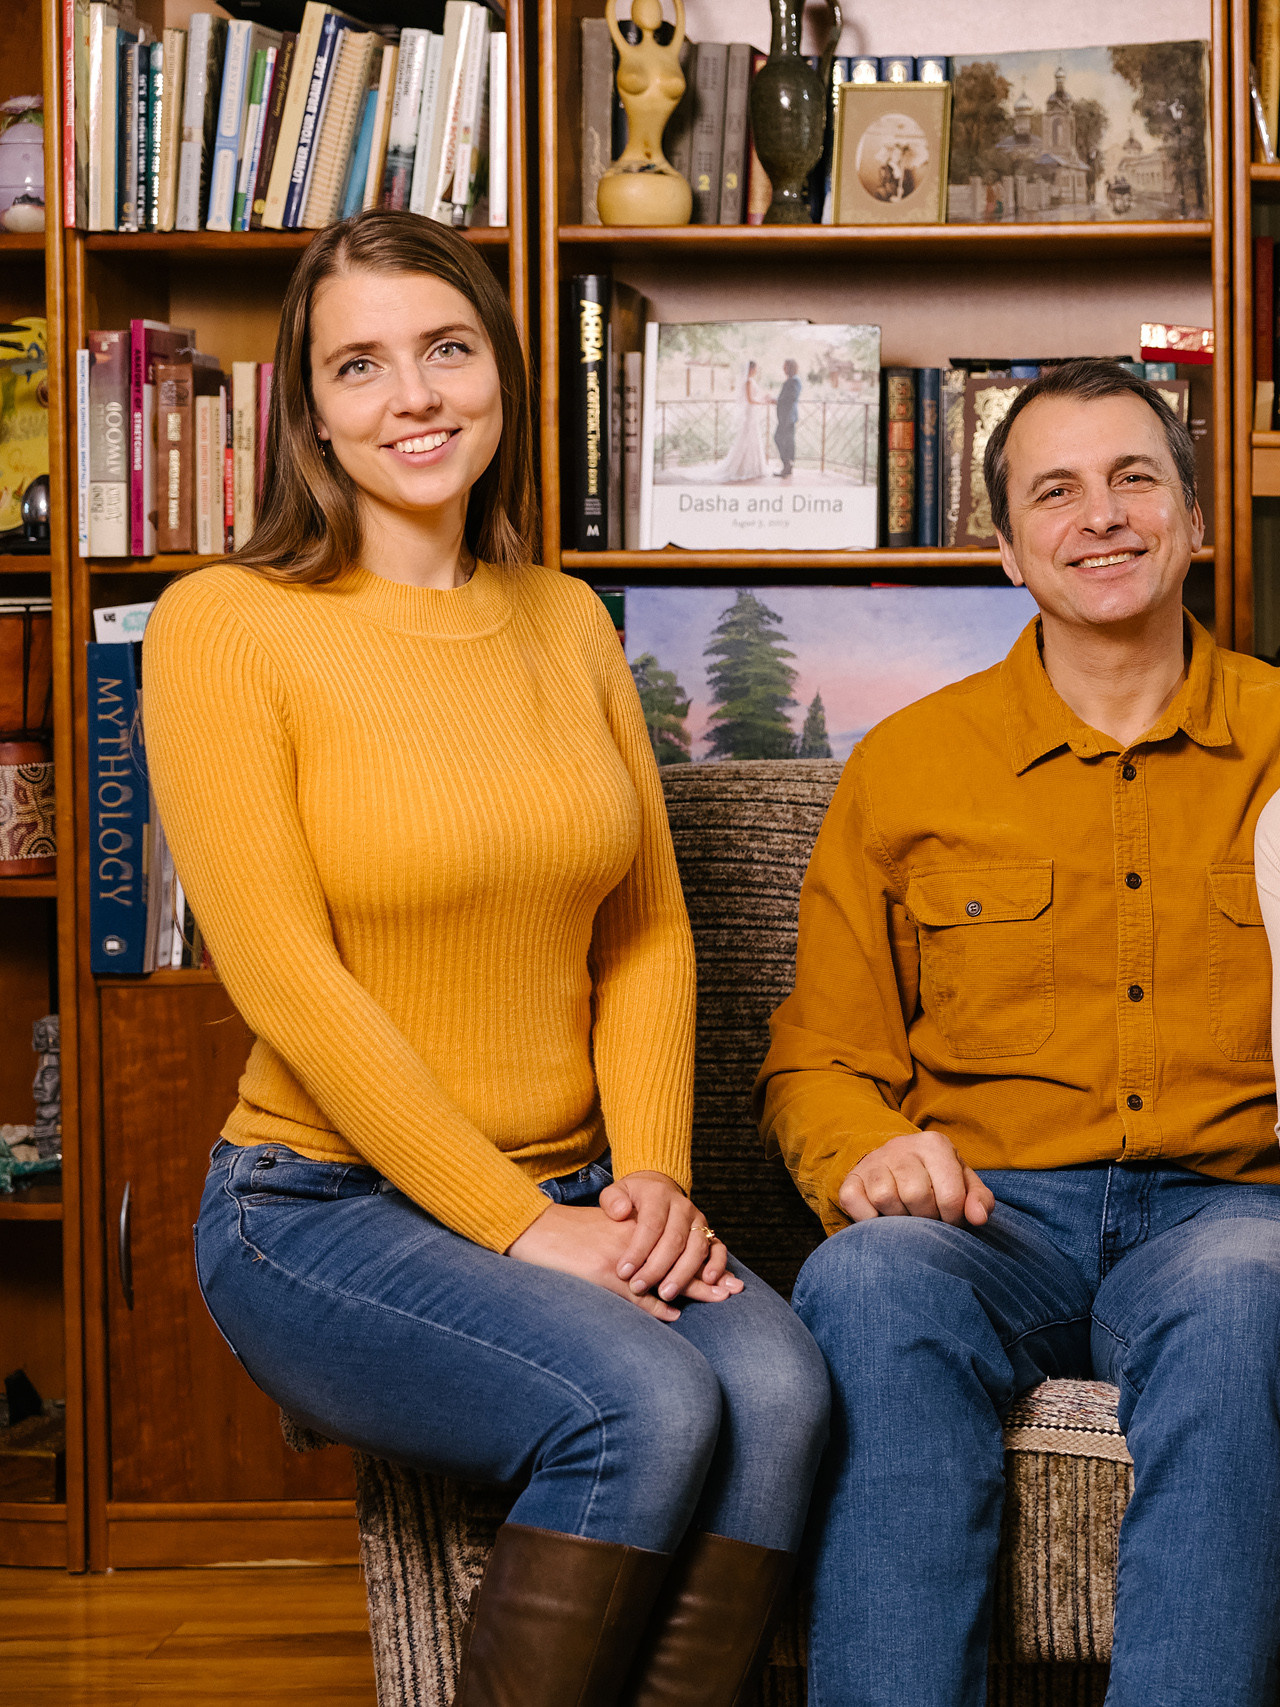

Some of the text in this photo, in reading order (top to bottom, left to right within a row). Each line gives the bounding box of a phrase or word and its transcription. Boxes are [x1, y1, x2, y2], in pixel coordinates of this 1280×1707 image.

[291, 55, 327, 184] LOWER YOUR BRAIN AGE
[697, 175, 711, 191] 2
[725, 173, 738, 190] 3
[580, 299, 603, 364] ABBA
[133, 349, 142, 471] ANATOMY OF STRETCHING
[105, 401, 123, 475] ATWOOD
[586, 434, 599, 467] PHOTO
[586, 468, 598, 494] BOOK
[679, 494, 843, 512] Dasha and Dima
[586, 524, 600, 537] M
[97, 677, 133, 907] MYTHOLOGY
